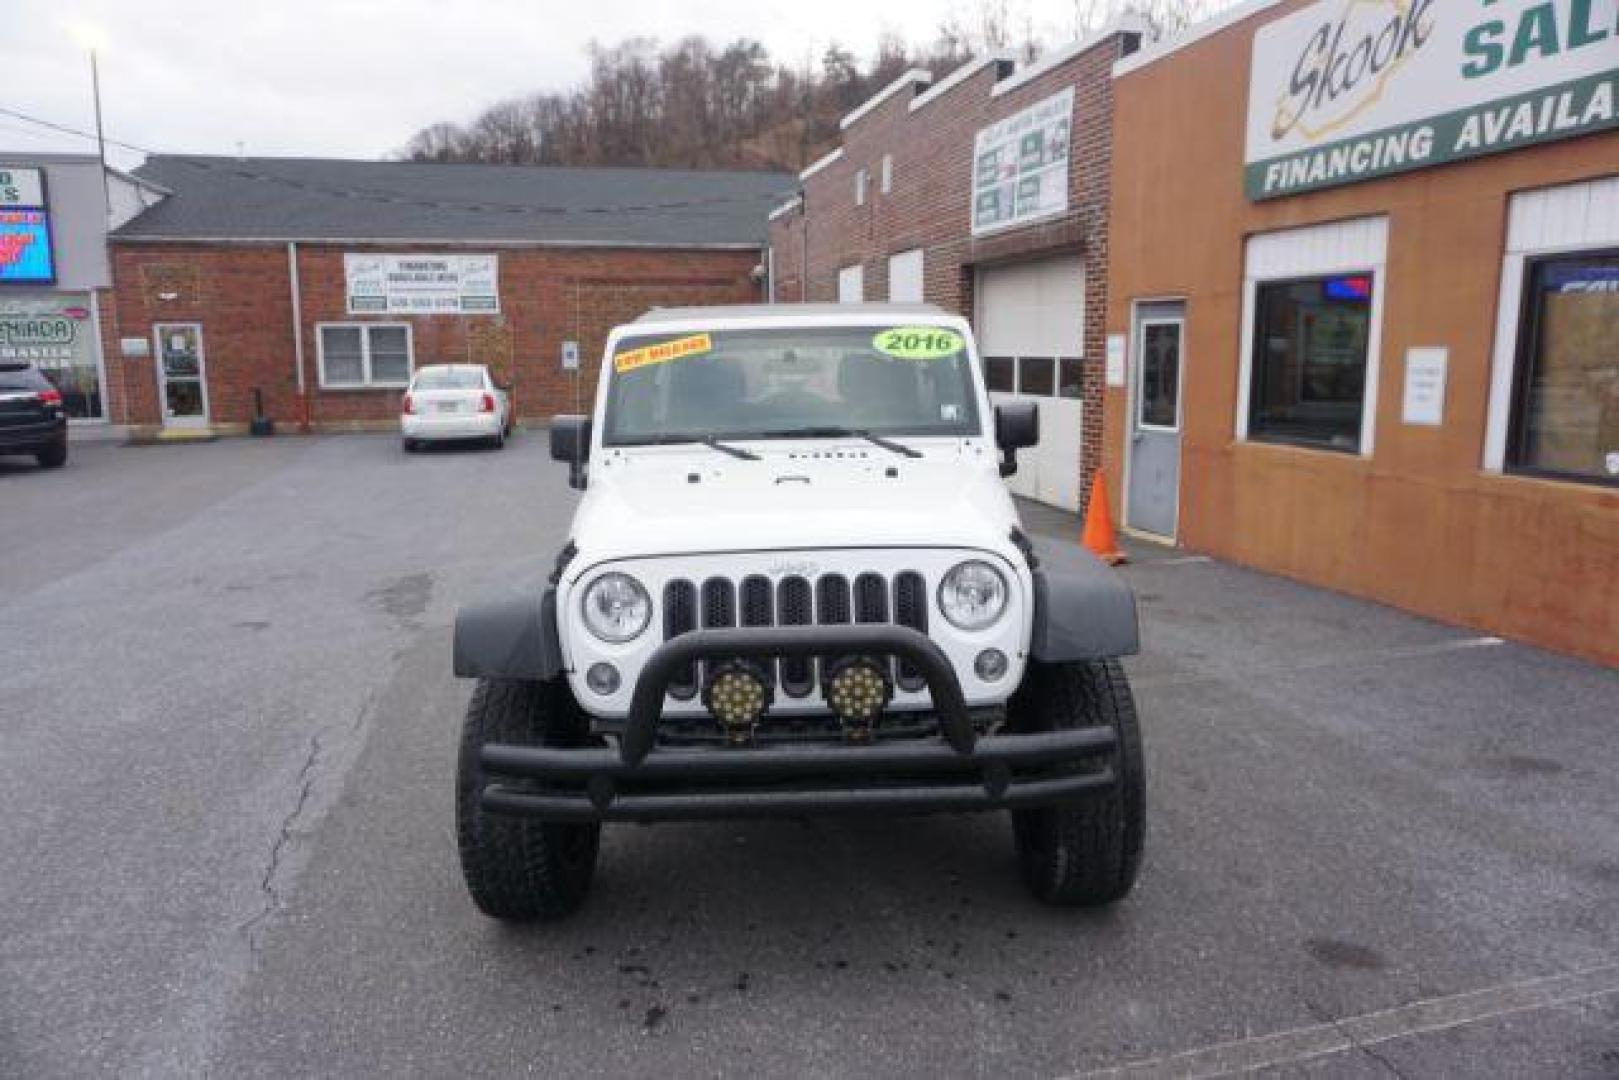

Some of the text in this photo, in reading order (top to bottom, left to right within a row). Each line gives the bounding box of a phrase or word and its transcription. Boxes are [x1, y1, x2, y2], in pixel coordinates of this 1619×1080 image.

[1462, 0, 1619, 78] SAL
[1264, 81, 1619, 192] FINANCING AVAILA
[887, 333, 952, 349] 2016
